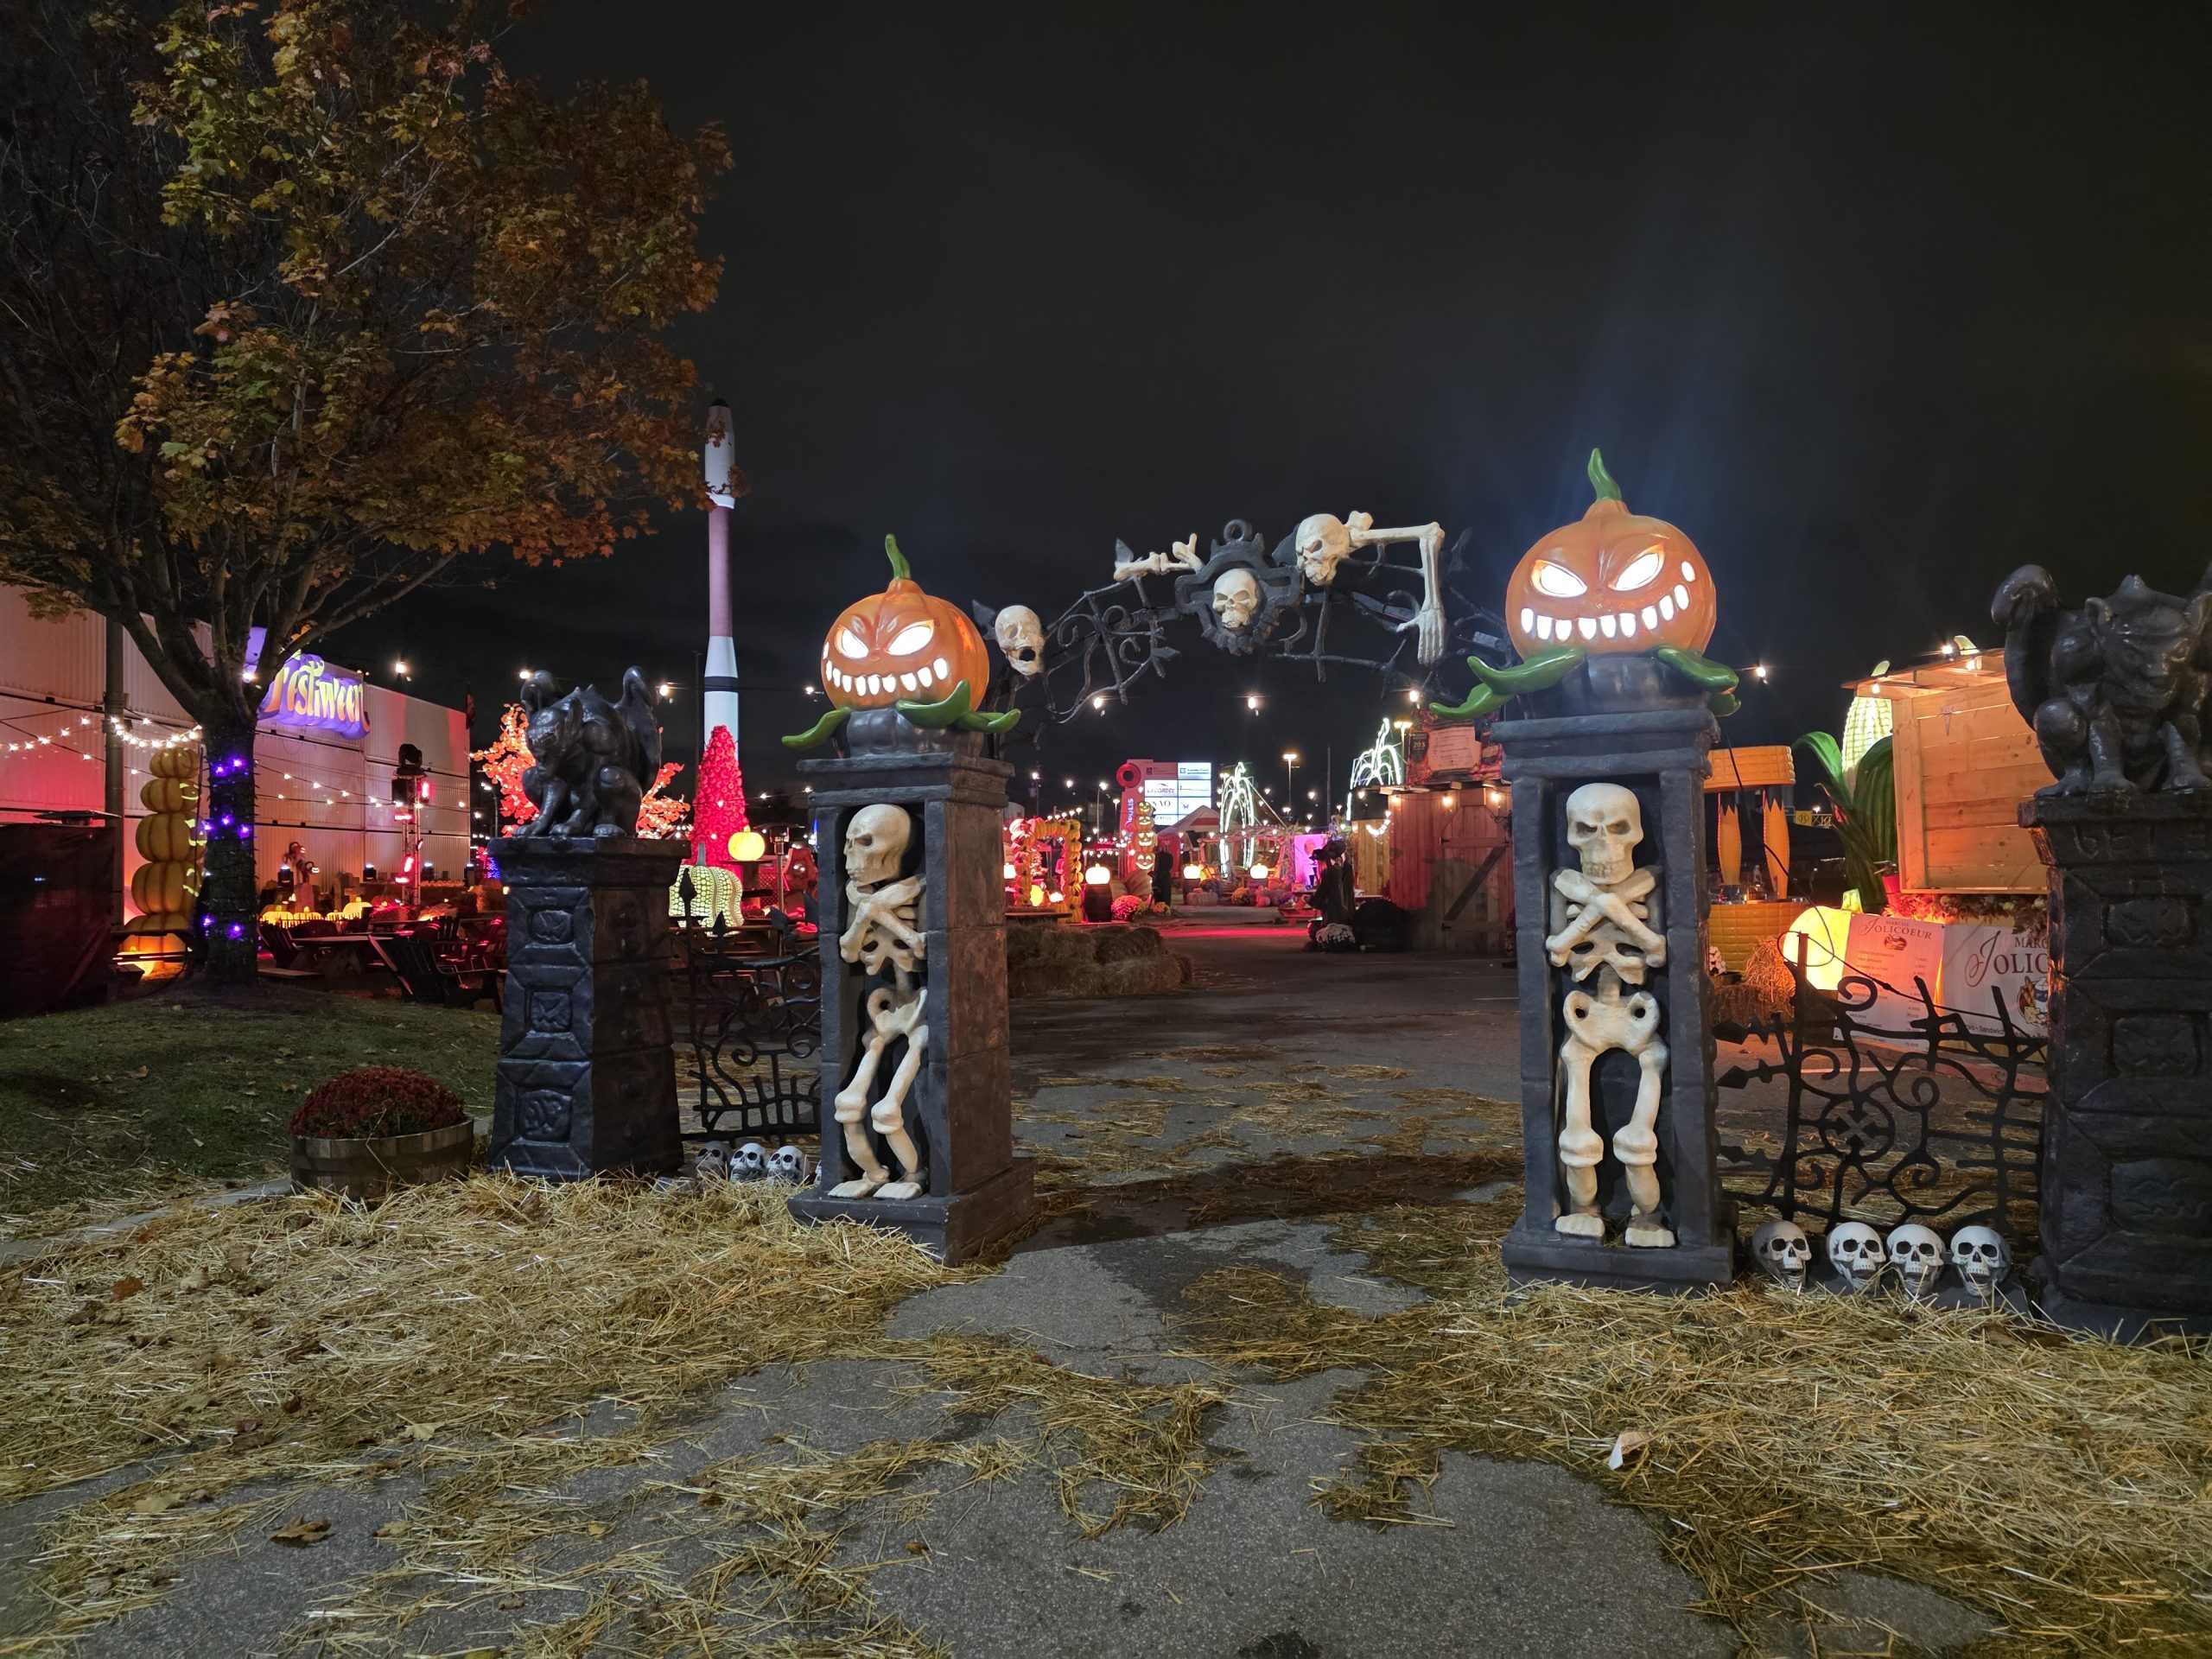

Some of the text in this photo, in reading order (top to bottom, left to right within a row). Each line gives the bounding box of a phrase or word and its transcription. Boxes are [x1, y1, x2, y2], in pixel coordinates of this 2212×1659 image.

[1859, 917, 1932, 939] JOLICOEUR
[2015, 937, 2048, 949] MARC
[1965, 930, 2048, 987] JOLIC
